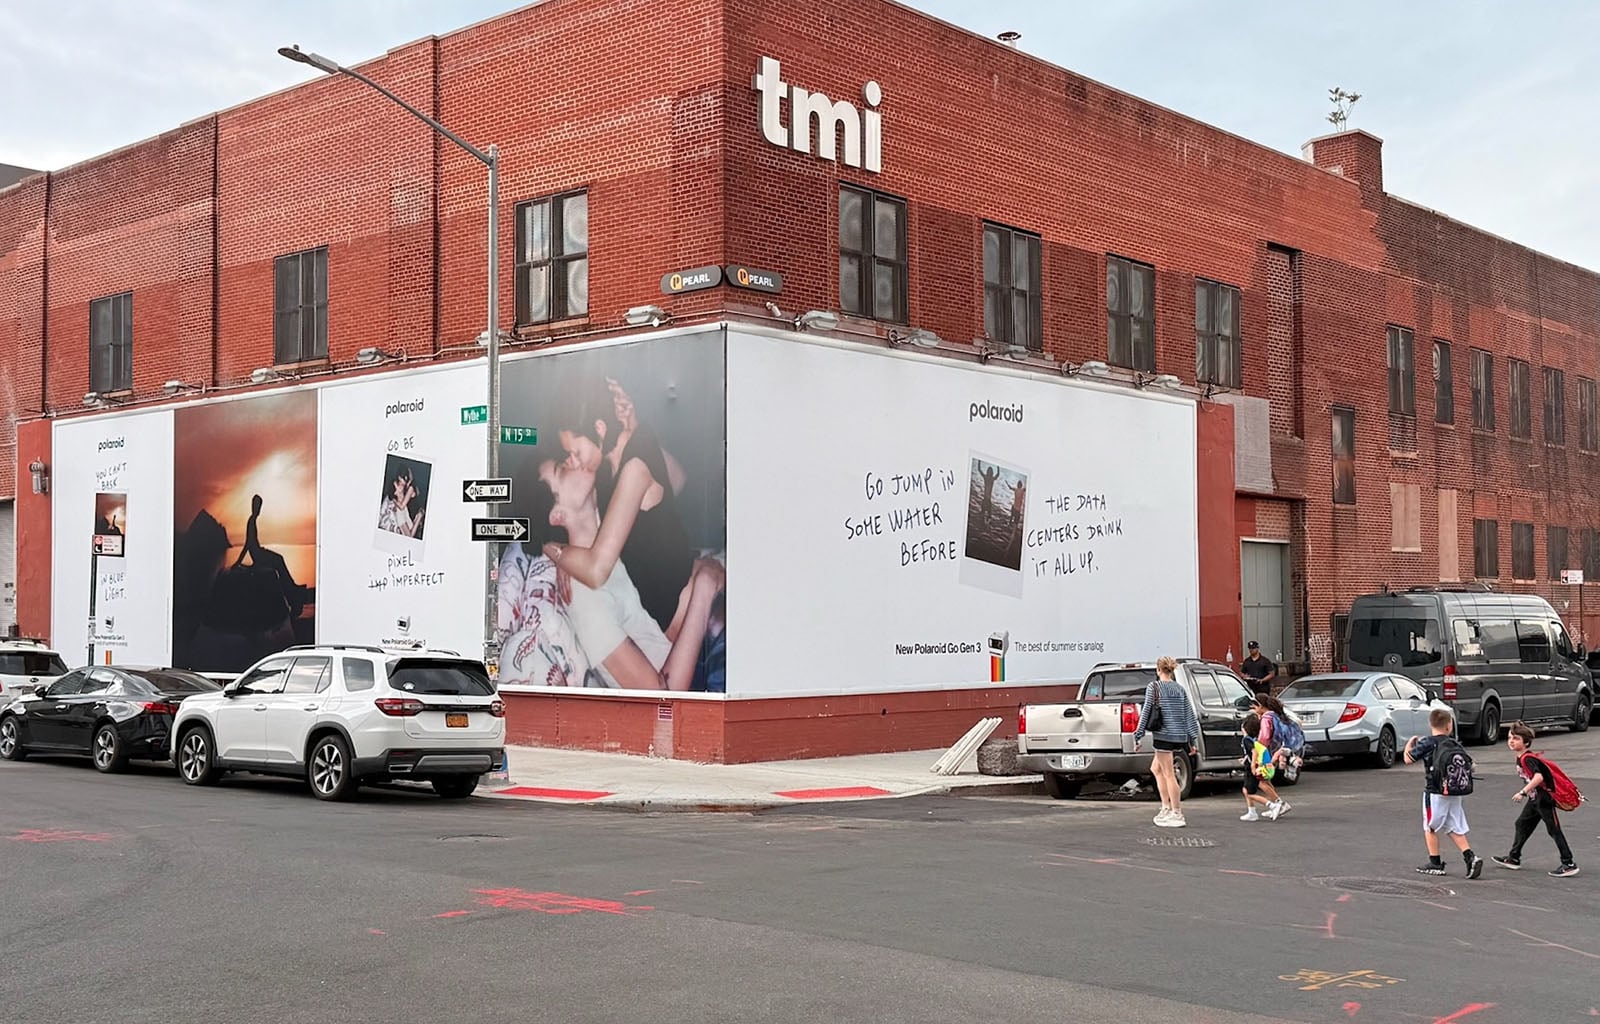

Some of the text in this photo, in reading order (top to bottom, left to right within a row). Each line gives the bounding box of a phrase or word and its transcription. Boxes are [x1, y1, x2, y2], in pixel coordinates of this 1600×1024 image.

[752, 55, 882, 174] tmi
[682, 273, 710, 286] PEARL
[748, 275, 774, 287] PEARL
[385, 398, 424, 419] polaroid
[969, 399, 1023, 423] polaroid
[403, 436, 415, 450] BE
[505, 427, 511, 441] N
[514, 428, 523, 442] 15
[98, 436, 125, 453] polaroid
[469, 486, 505, 496] ONE WAY
[866, 472, 883, 500] GO
[891, 468, 932, 495] JUMP
[1045, 494, 1106, 514] THE DATA
[480, 525, 521, 535] ONE WAY
[845, 502, 943, 540] SOME WATER
[1027, 523, 1080, 548] CENTERS
[901, 539, 957, 567] BEFORE
[1054, 553, 1076, 576] ALL
[1080, 550, 1099, 574] UP.
[895, 642, 982, 655] New Polaroid Go Gen 3
[1015, 640, 1105, 653] The best of summer is analog
